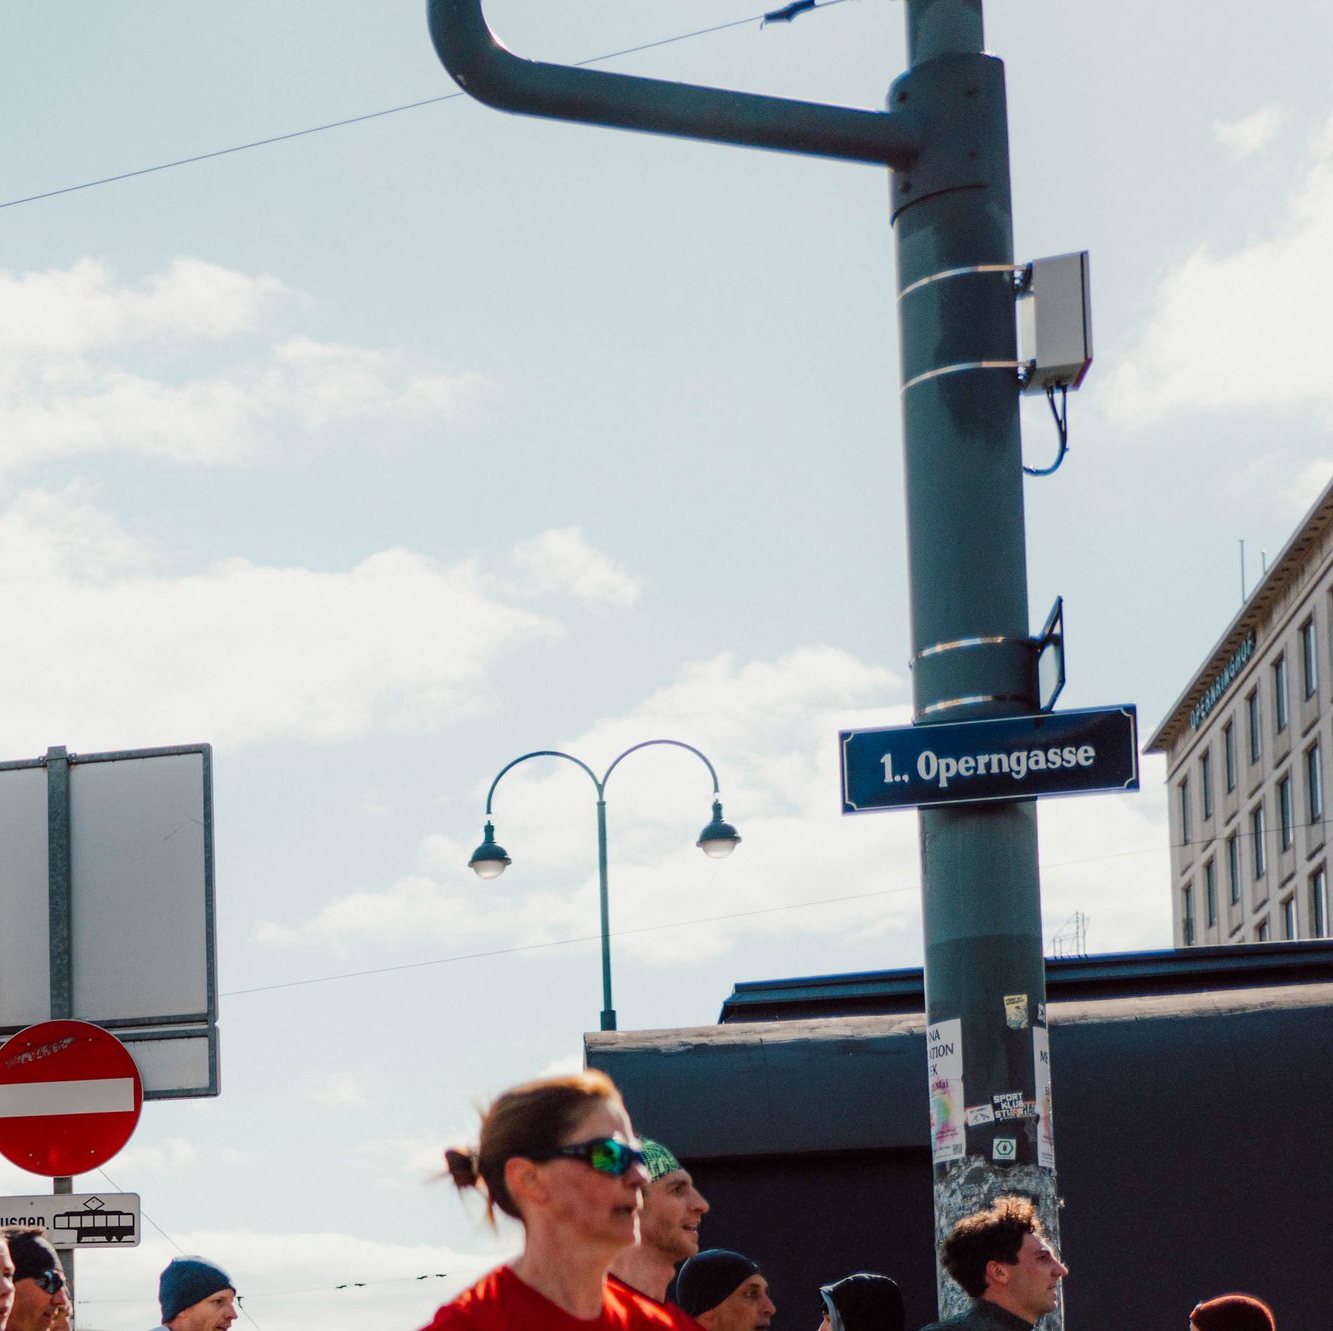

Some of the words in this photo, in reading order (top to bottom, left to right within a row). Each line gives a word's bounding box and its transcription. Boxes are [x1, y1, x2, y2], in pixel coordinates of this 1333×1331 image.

[917, 745, 1096, 788] Operngasse
[993, 1092, 1023, 1103] SPORT
[1001, 1100, 1024, 1110] KLUB
